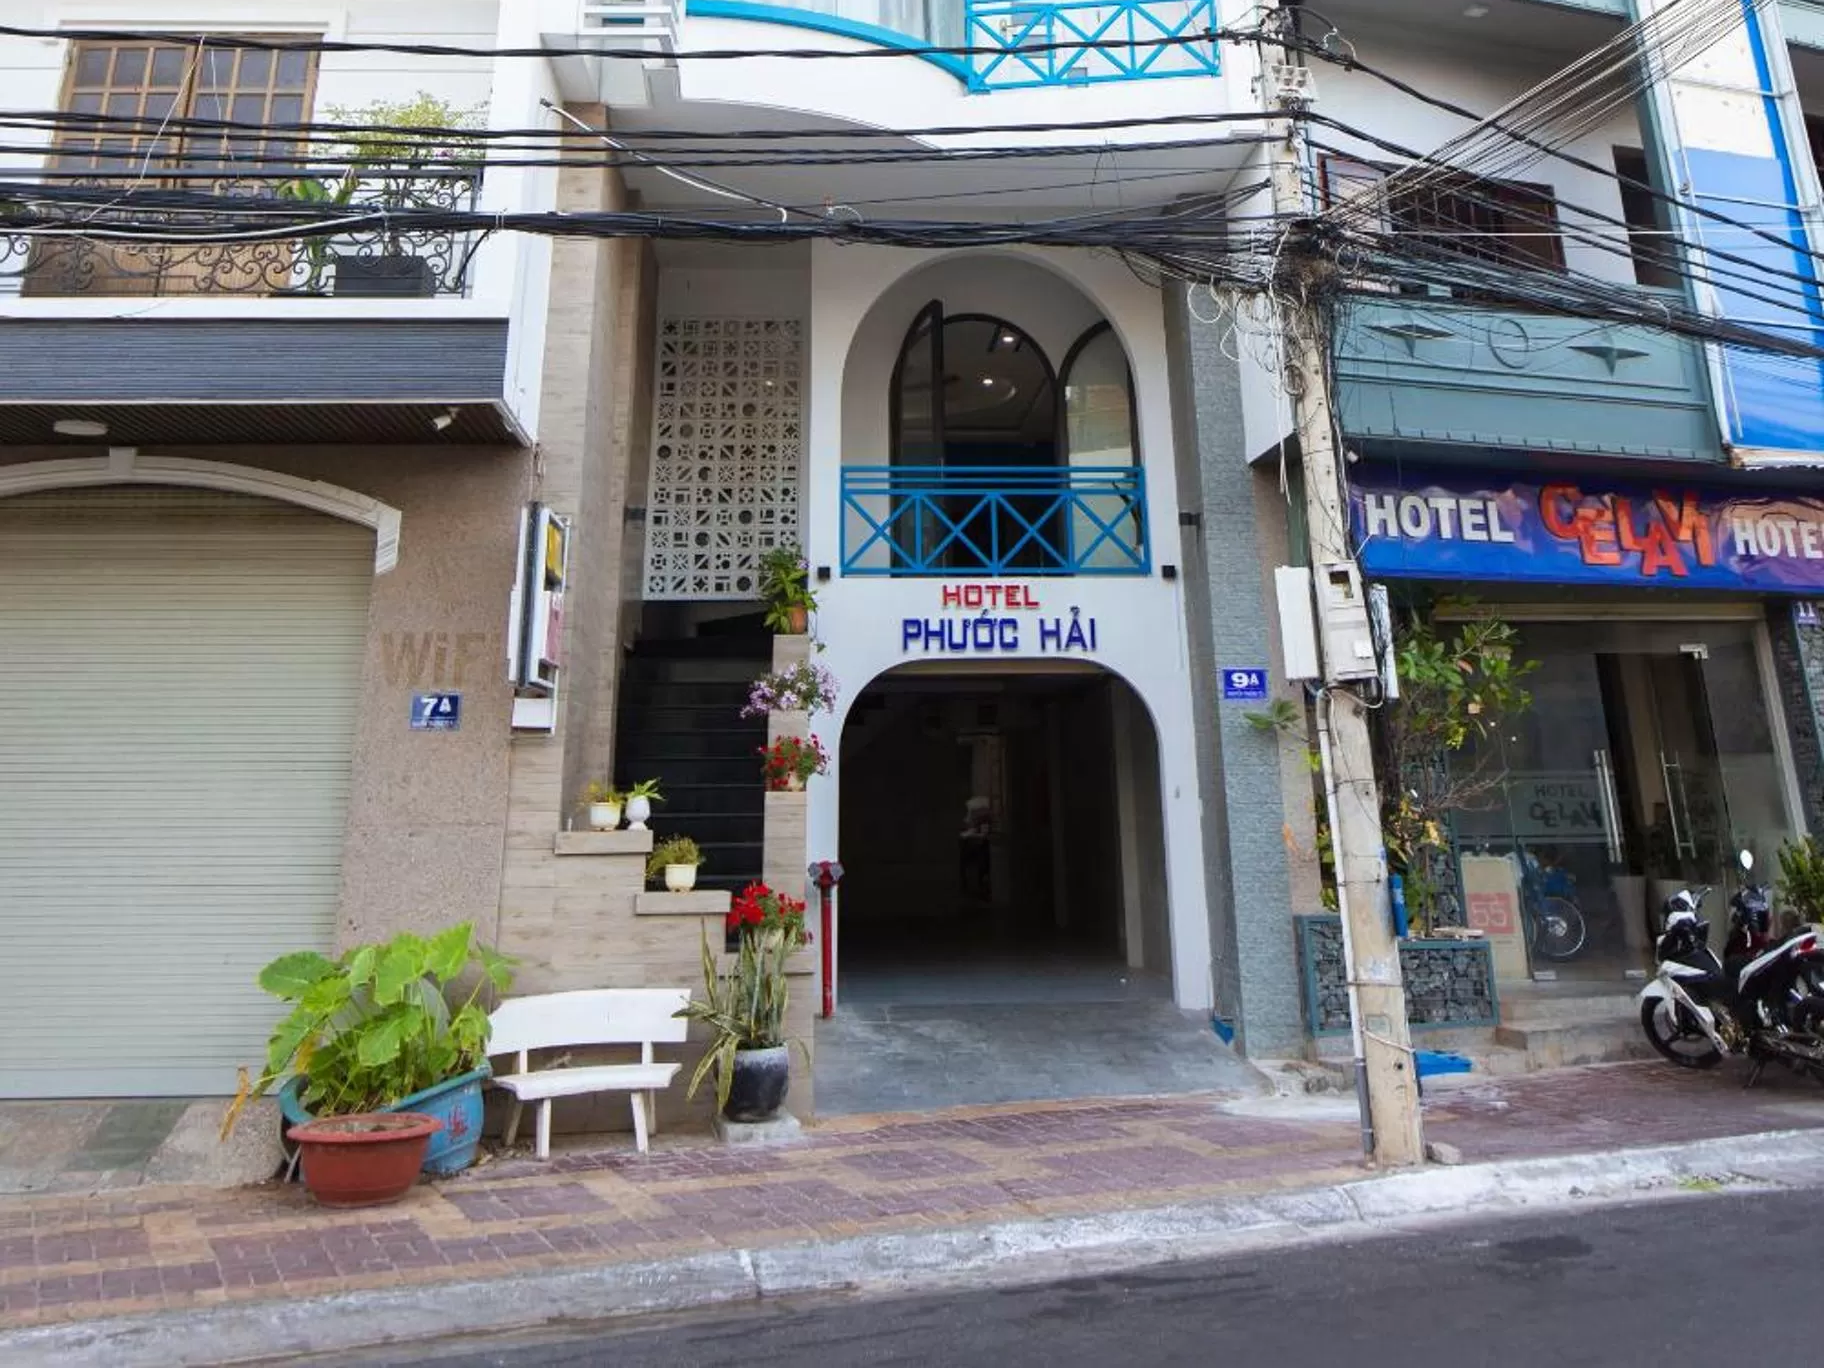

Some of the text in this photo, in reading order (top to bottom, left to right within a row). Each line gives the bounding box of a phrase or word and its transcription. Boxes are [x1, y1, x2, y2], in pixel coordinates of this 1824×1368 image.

[1365, 494, 1515, 542] HOTEL
[1732, 518, 1824, 558] HOTE
[943, 585, 1039, 608] HOTEL
[903, 606, 1096, 651] PHƯỚC HẢI
[1231, 672, 1260, 689] 9A
[420, 697, 452, 716] 7A
